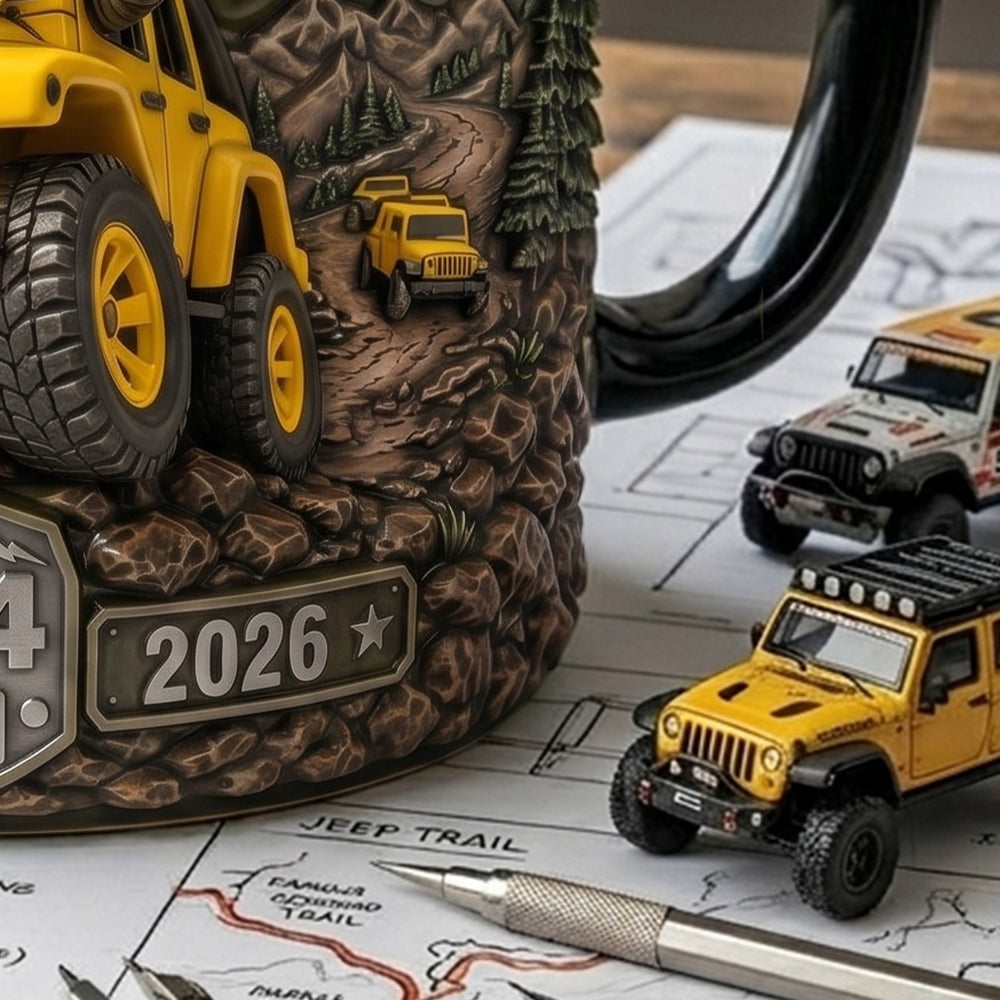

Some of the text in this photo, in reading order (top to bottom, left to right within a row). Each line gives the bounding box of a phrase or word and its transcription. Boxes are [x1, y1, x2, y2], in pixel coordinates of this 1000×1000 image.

[143, 604, 331, 707] 2026
[299, 816, 528, 853] JEEP TRAIL
